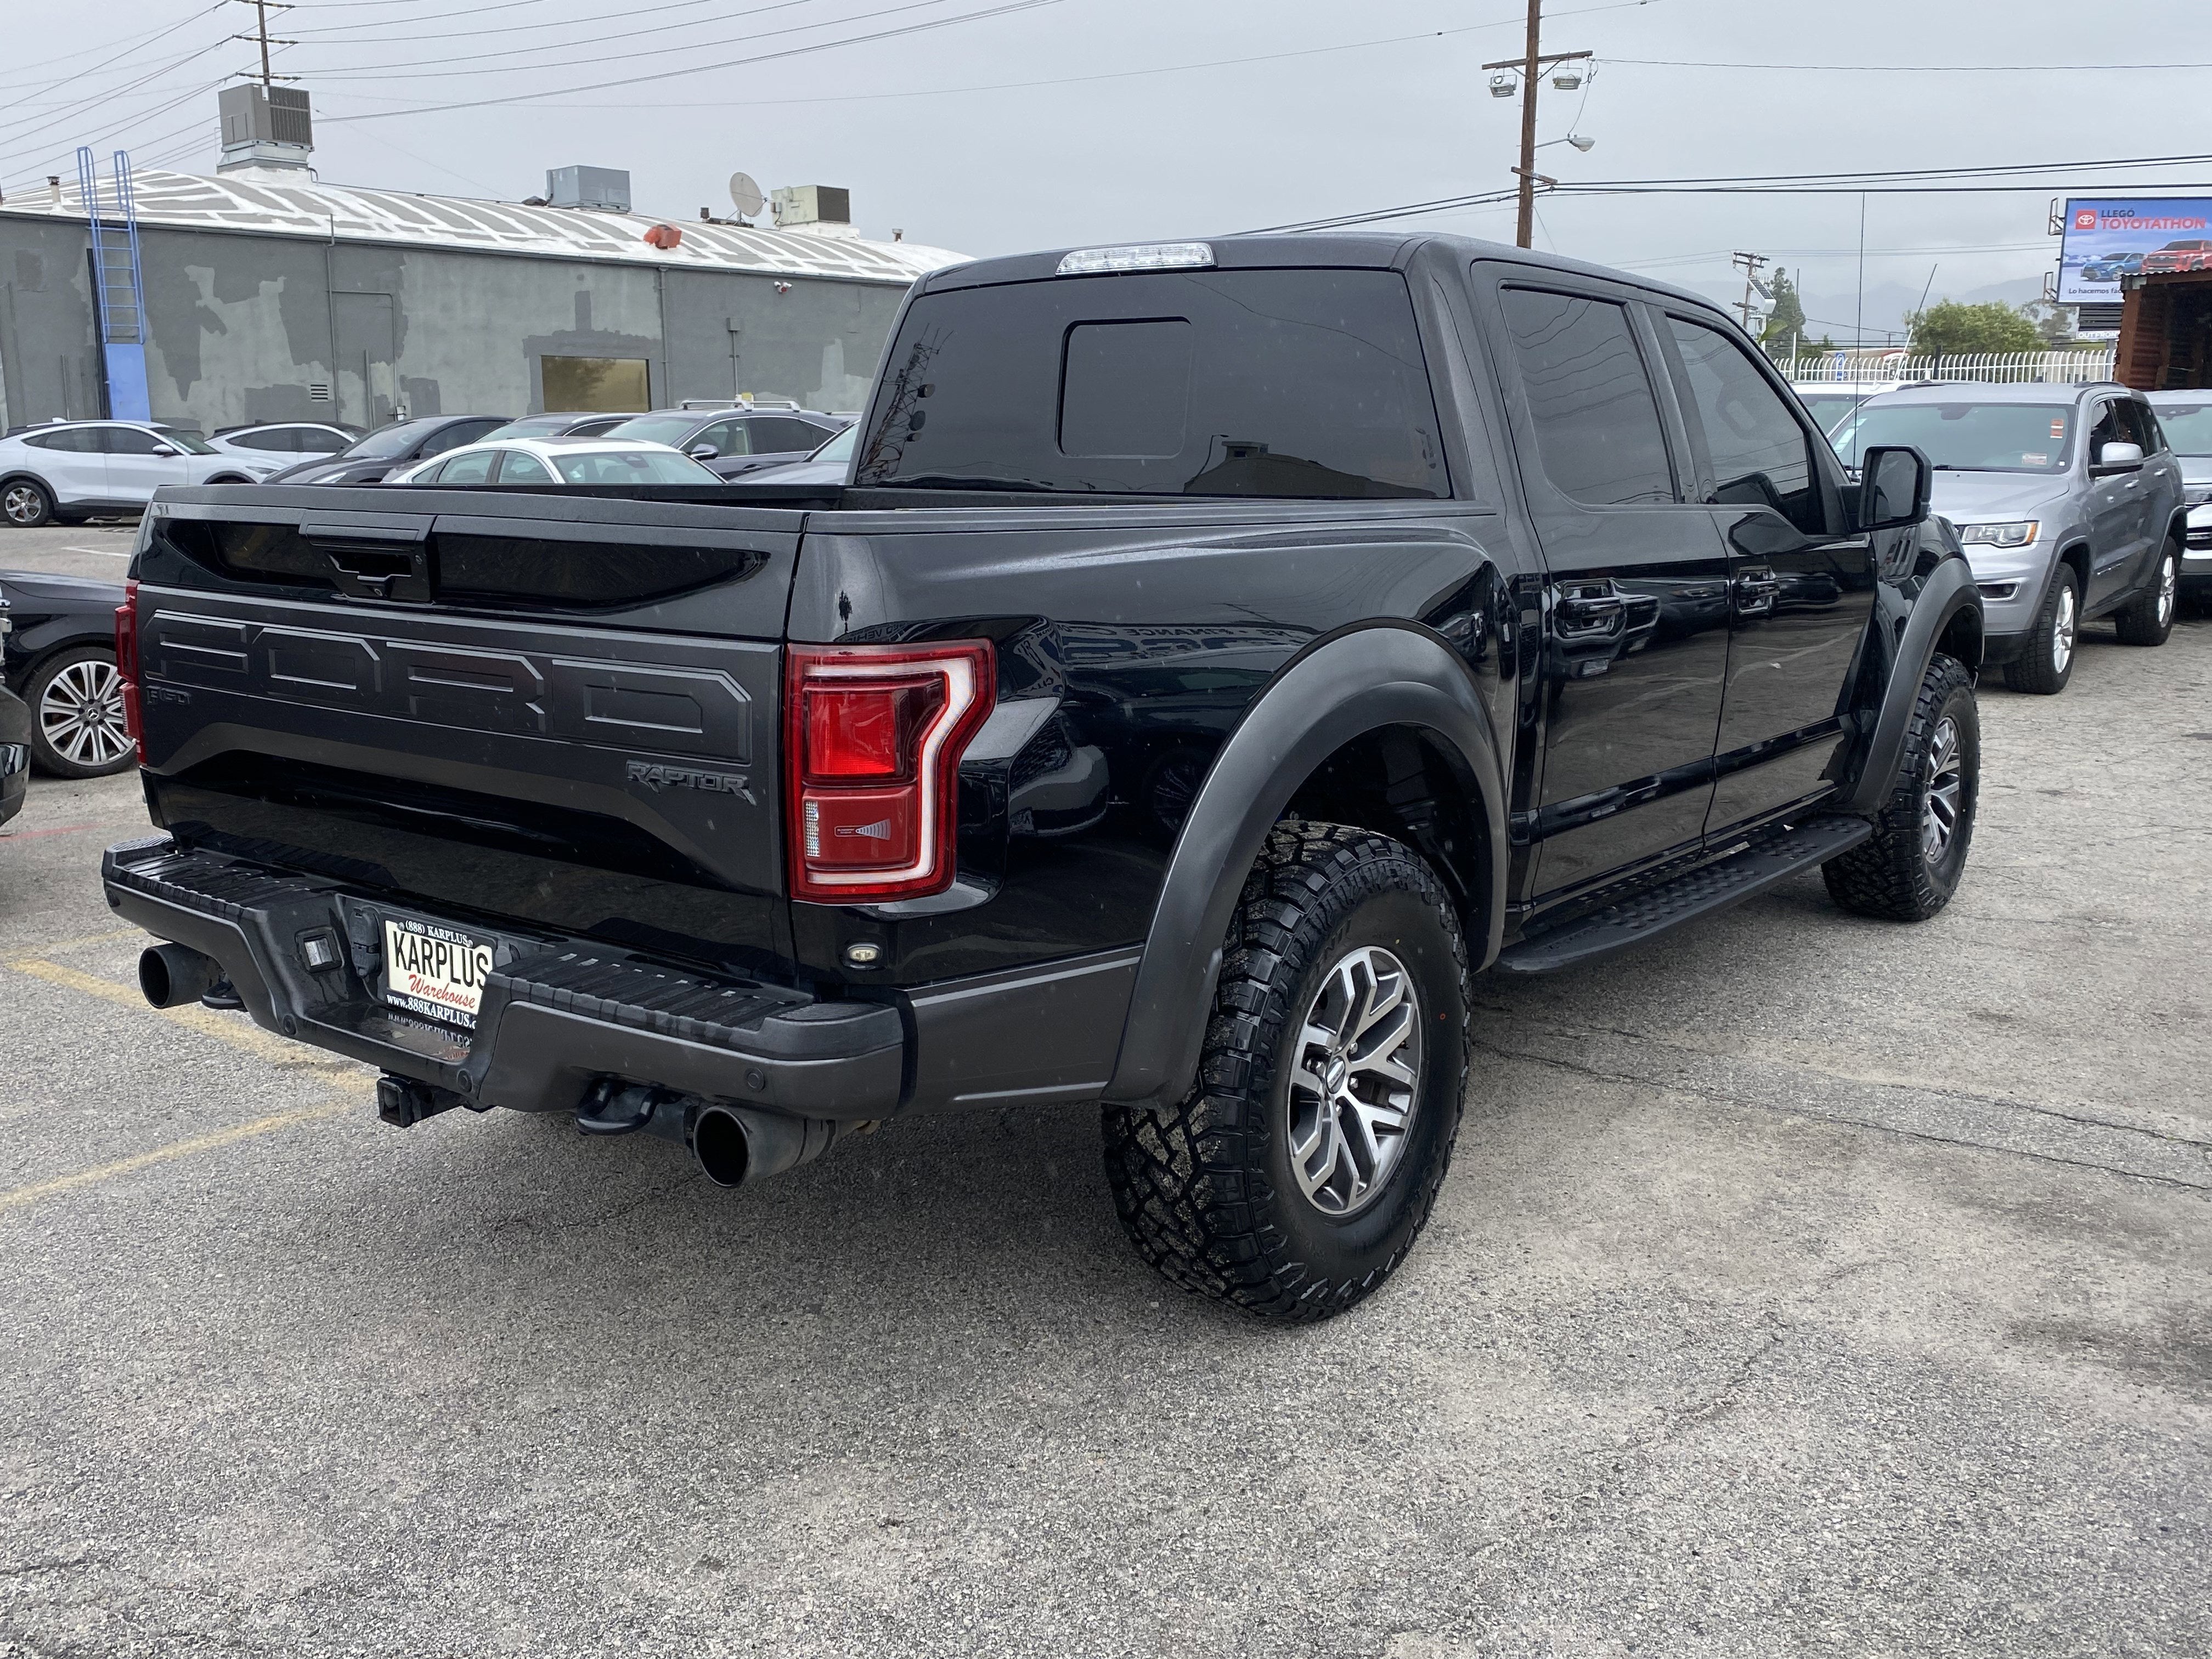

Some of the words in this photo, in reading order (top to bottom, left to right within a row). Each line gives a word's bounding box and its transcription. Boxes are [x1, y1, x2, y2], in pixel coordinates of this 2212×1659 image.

[2101, 208, 2135, 217] LLEGÓ
[2101, 218, 2206, 229] TOYOTATHON
[144, 609, 752, 766] FORD
[627, 759, 757, 806] RAPTOR
[405, 920, 425, 933] (888)
[427, 925, 468, 944] KARPLUS
[393, 930, 488, 991] KARPLUS
[409, 974, 476, 1008] Warehouse
